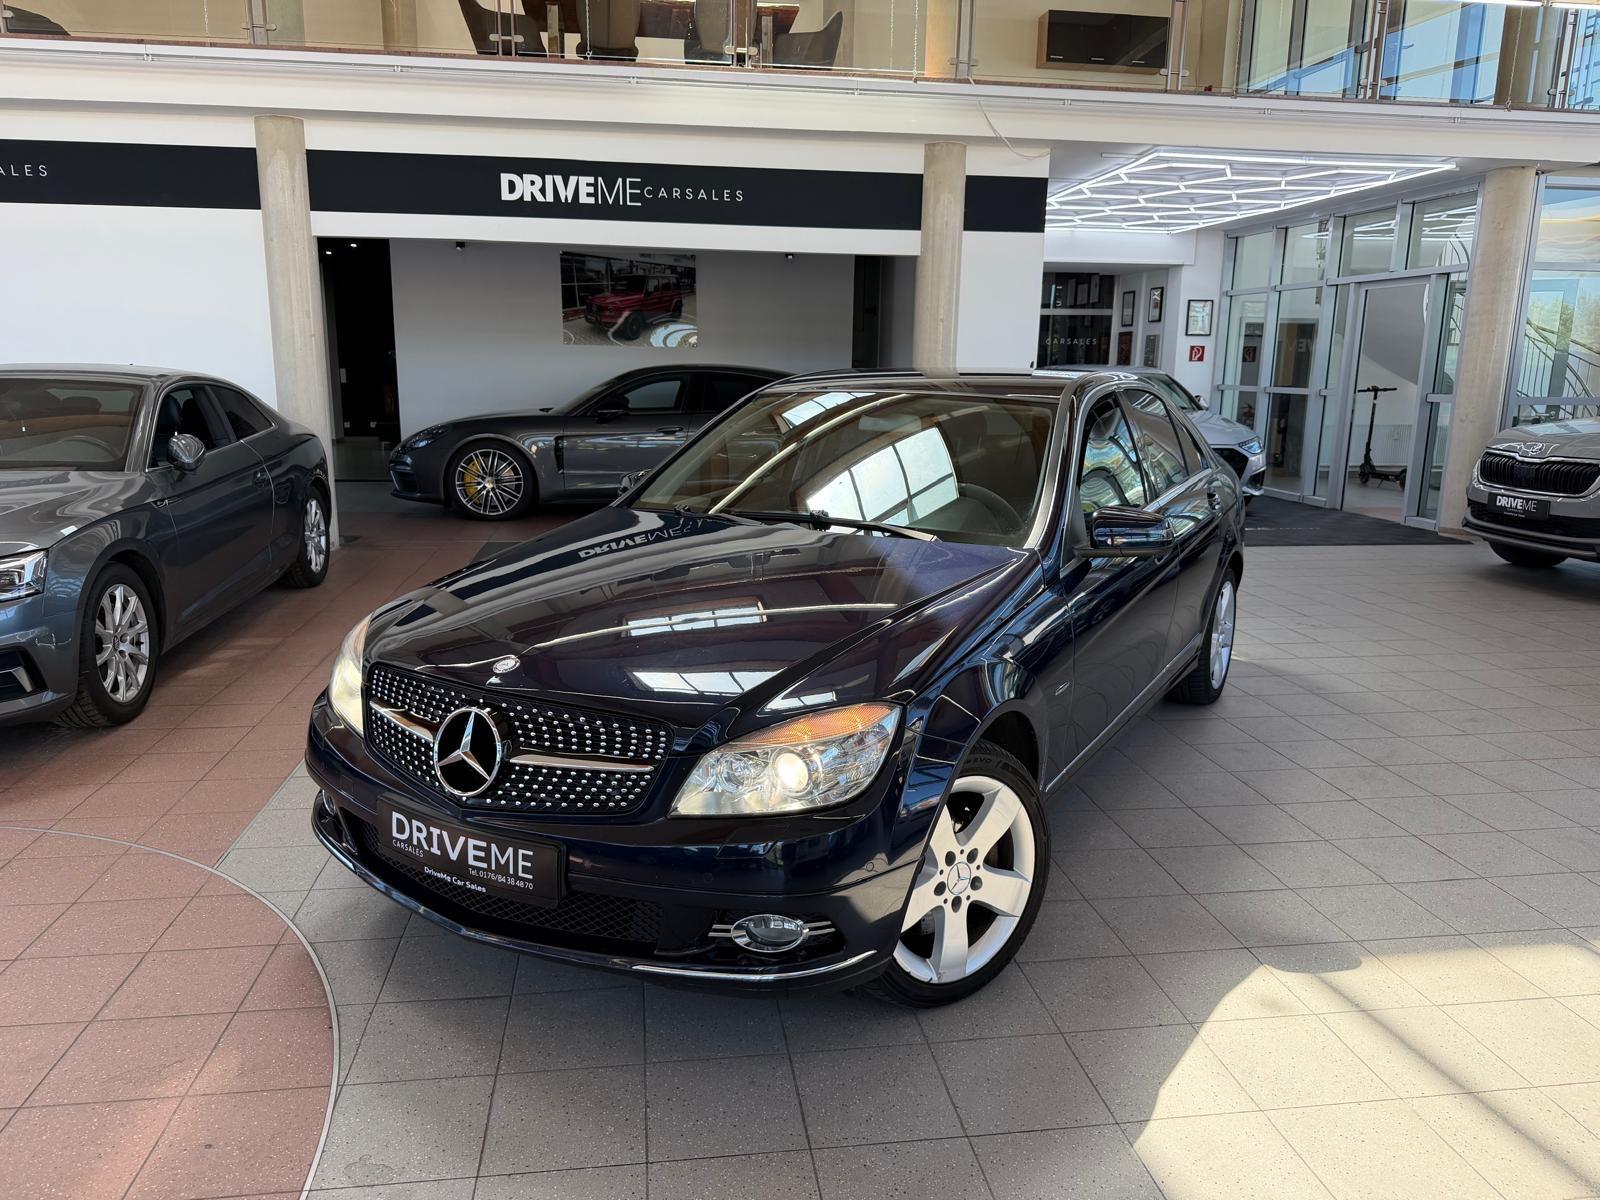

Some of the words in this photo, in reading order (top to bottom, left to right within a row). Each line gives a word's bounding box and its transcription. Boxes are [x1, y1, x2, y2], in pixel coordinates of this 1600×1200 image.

[500, 172, 642, 206] DRIVEME
[643, 186, 744, 202] CARSALES
[1496, 495, 1538, 512] DRIVEME
[391, 811, 534, 880] DRIVEME
[392, 839, 424, 858] CARSALES
[424, 866, 451, 882] DriveMe
[452, 876, 465, 886] Car
[465, 881, 487, 893] Sales
